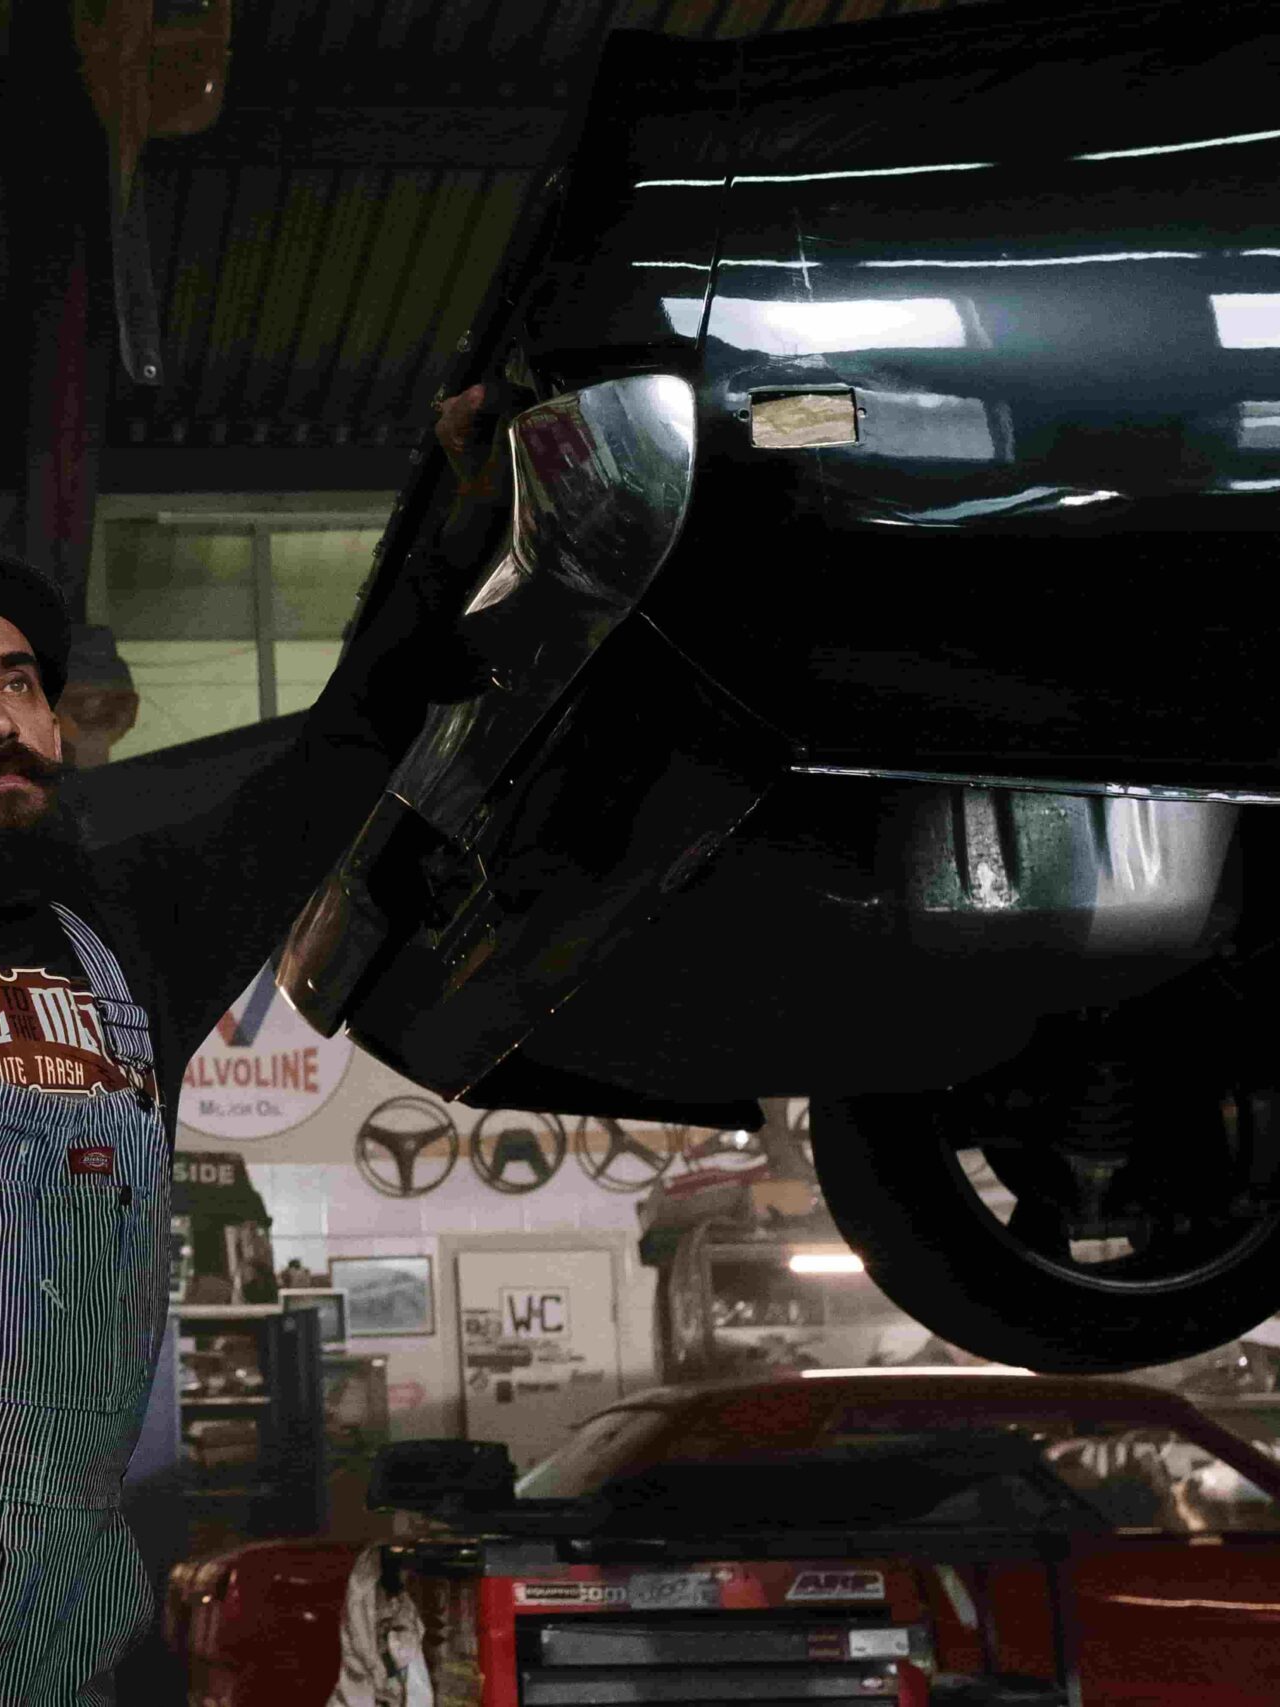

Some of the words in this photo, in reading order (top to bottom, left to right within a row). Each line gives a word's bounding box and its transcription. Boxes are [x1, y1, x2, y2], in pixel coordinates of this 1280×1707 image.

[0, 986, 29, 1011] TO
[9, 1014, 37, 1041] THE
[35, 1055, 85, 1086] TRASH
[183, 1047, 320, 1094] ALVOLINE
